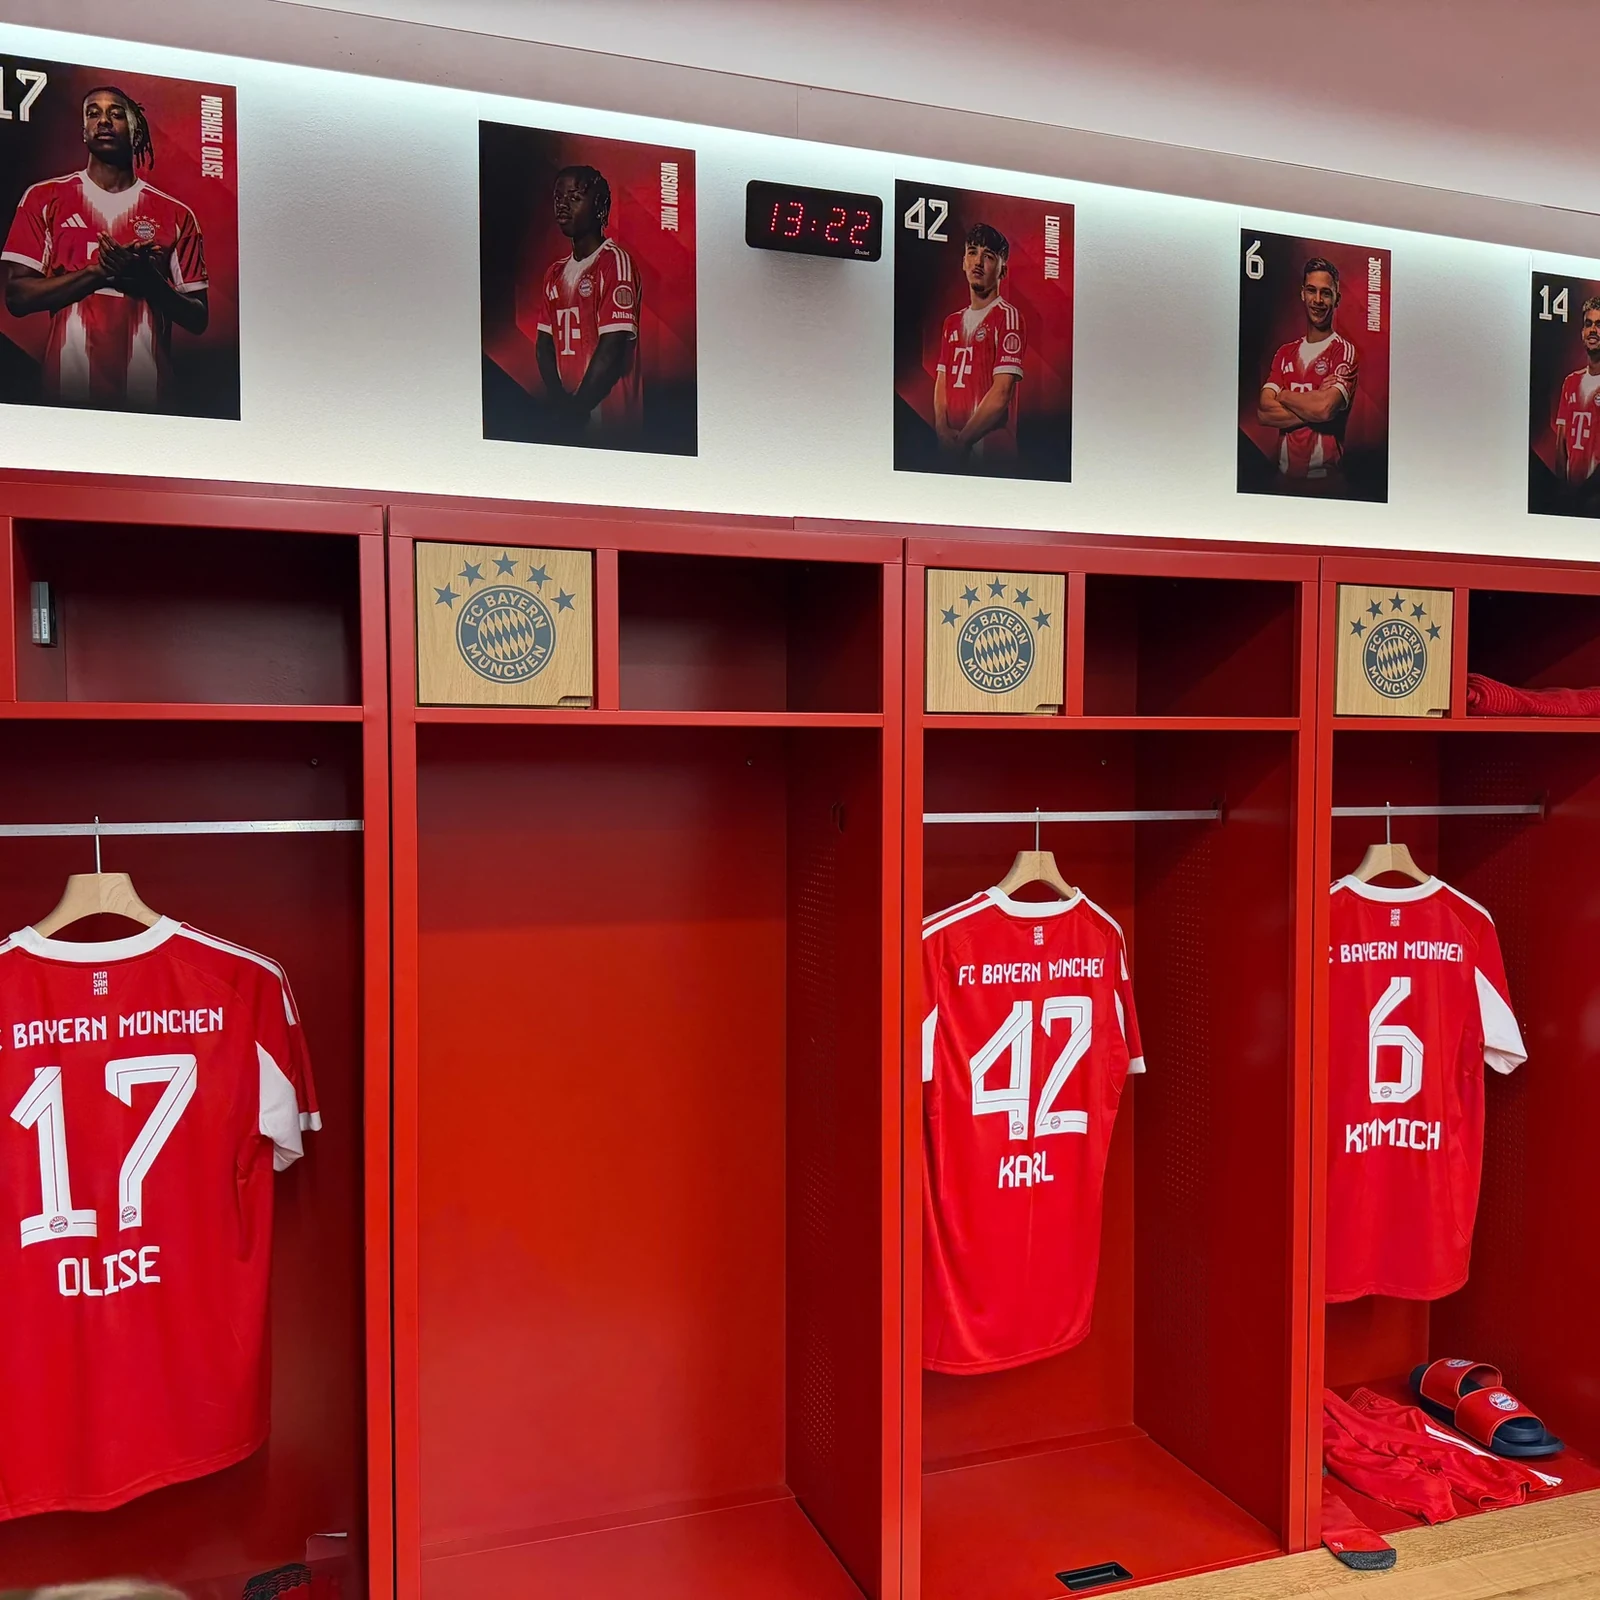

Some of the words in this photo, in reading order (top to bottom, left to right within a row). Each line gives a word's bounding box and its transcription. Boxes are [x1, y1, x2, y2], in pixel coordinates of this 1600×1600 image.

[201, 95, 223, 143] MICHAEL
[201, 146, 223, 179] OLISE
[660, 162, 679, 205] WISDOM
[661, 206, 679, 232] MIKE
[770, 202, 871, 245] 13:22
[904, 197, 949, 243] 42
[1045, 215, 1060, 256] LENNART
[1044, 256, 1060, 280] KARL
[1245, 240, 1265, 280] 6
[1368, 257, 1382, 292] JOSHUA
[1367, 293, 1381, 332] KIMMICH
[1539, 285, 1569, 323] 14
[464, 604, 484, 627] FC
[483, 592, 547, 629] BAYERN
[964, 623, 979, 644] FC
[979, 612, 1029, 645] BAYERN
[1368, 634, 1382, 653] FC
[1381, 624, 1422, 654] BAYERN
[465, 642, 547, 678] MÜNCHEN
[1340, 941, 1398, 963] BAYERN
[958, 965, 976, 986] FC
[982, 961, 1041, 984] BAYERN
[13, 1015, 107, 1049] BAYERN
[119, 1007, 224, 1038] MÜNCHEN
[1369, 976, 1424, 1104] 6
[969, 995, 1093, 1141] 42
[10, 1053, 198, 1249] 17
[998, 1150, 1054, 1189] KARL
[58, 1245, 161, 1297] OLISE
